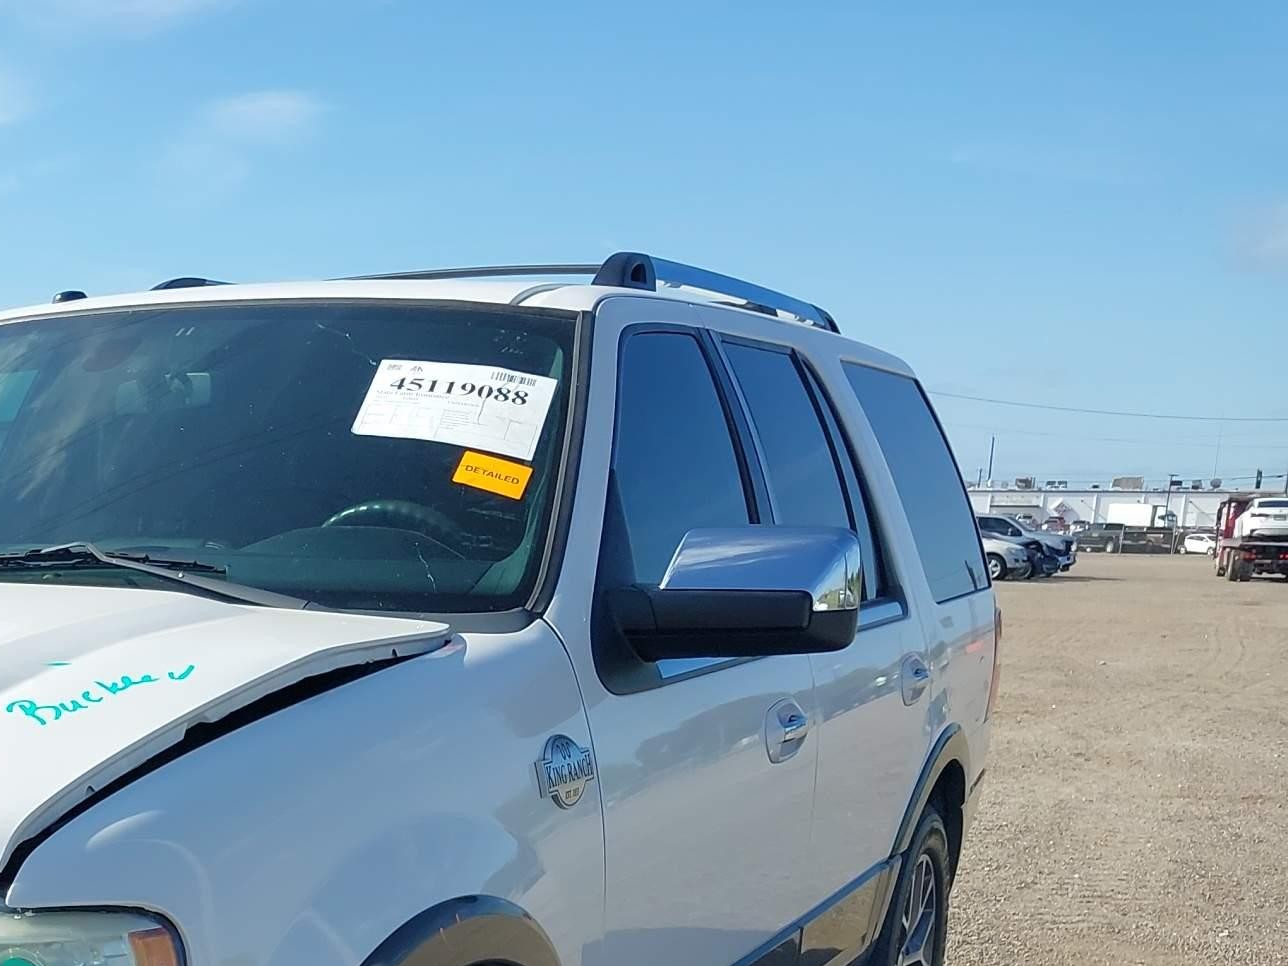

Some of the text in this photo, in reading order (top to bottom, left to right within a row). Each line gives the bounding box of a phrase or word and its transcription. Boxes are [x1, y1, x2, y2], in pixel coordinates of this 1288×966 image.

[390, 376, 529, 406] 45119088
[464, 464, 521, 485] DETAILED
[545, 754, 593, 789] KING RANCH
